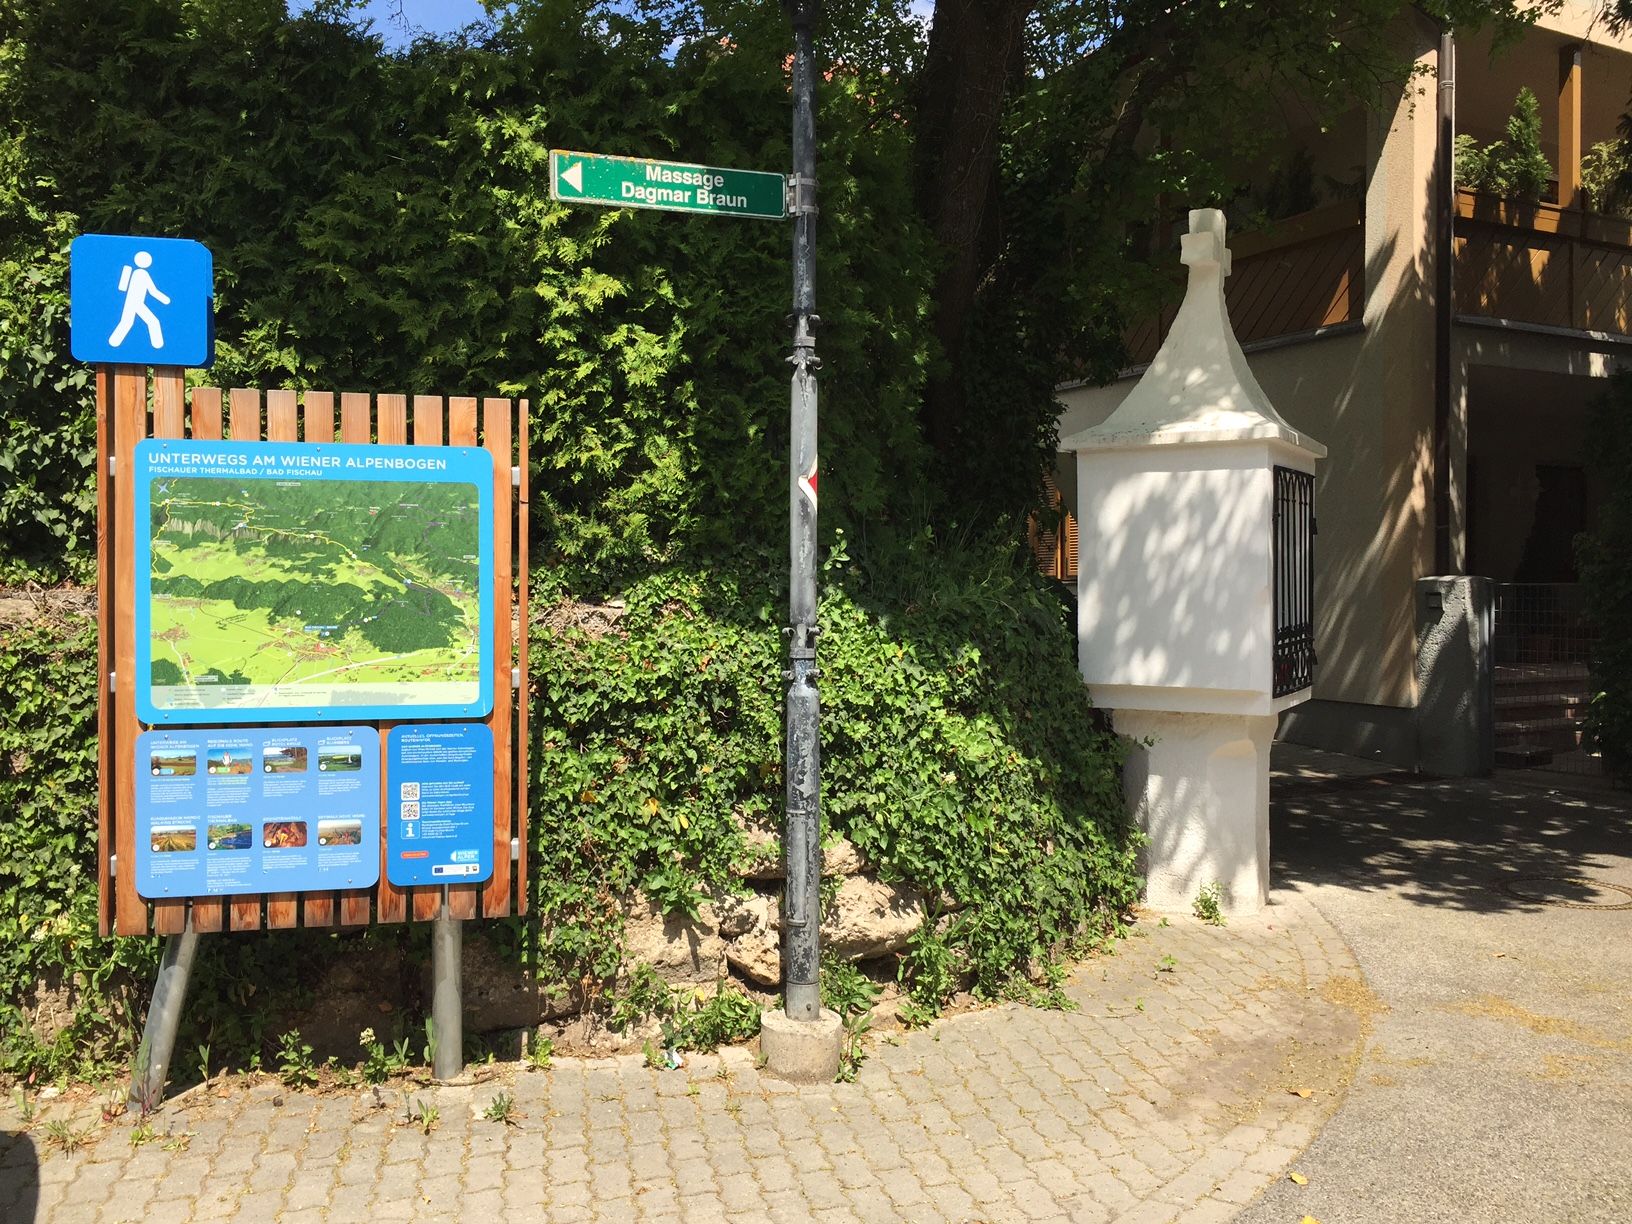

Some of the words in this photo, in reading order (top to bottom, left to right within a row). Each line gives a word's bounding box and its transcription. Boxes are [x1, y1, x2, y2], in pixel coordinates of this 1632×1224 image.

[645, 165, 725, 191] Massage
[621, 181, 692, 203] Dagmar
[696, 188, 747, 208] Braun
[148, 453, 248, 466] UNTERWEGS
[252, 455, 276, 467] AM
[280, 456, 341, 468] WIENER
[345, 457, 447, 470] ALPENBOGEN
[148, 466, 198, 474] FISCHAUER
[200, 467, 258, 475] THERMALBAD
